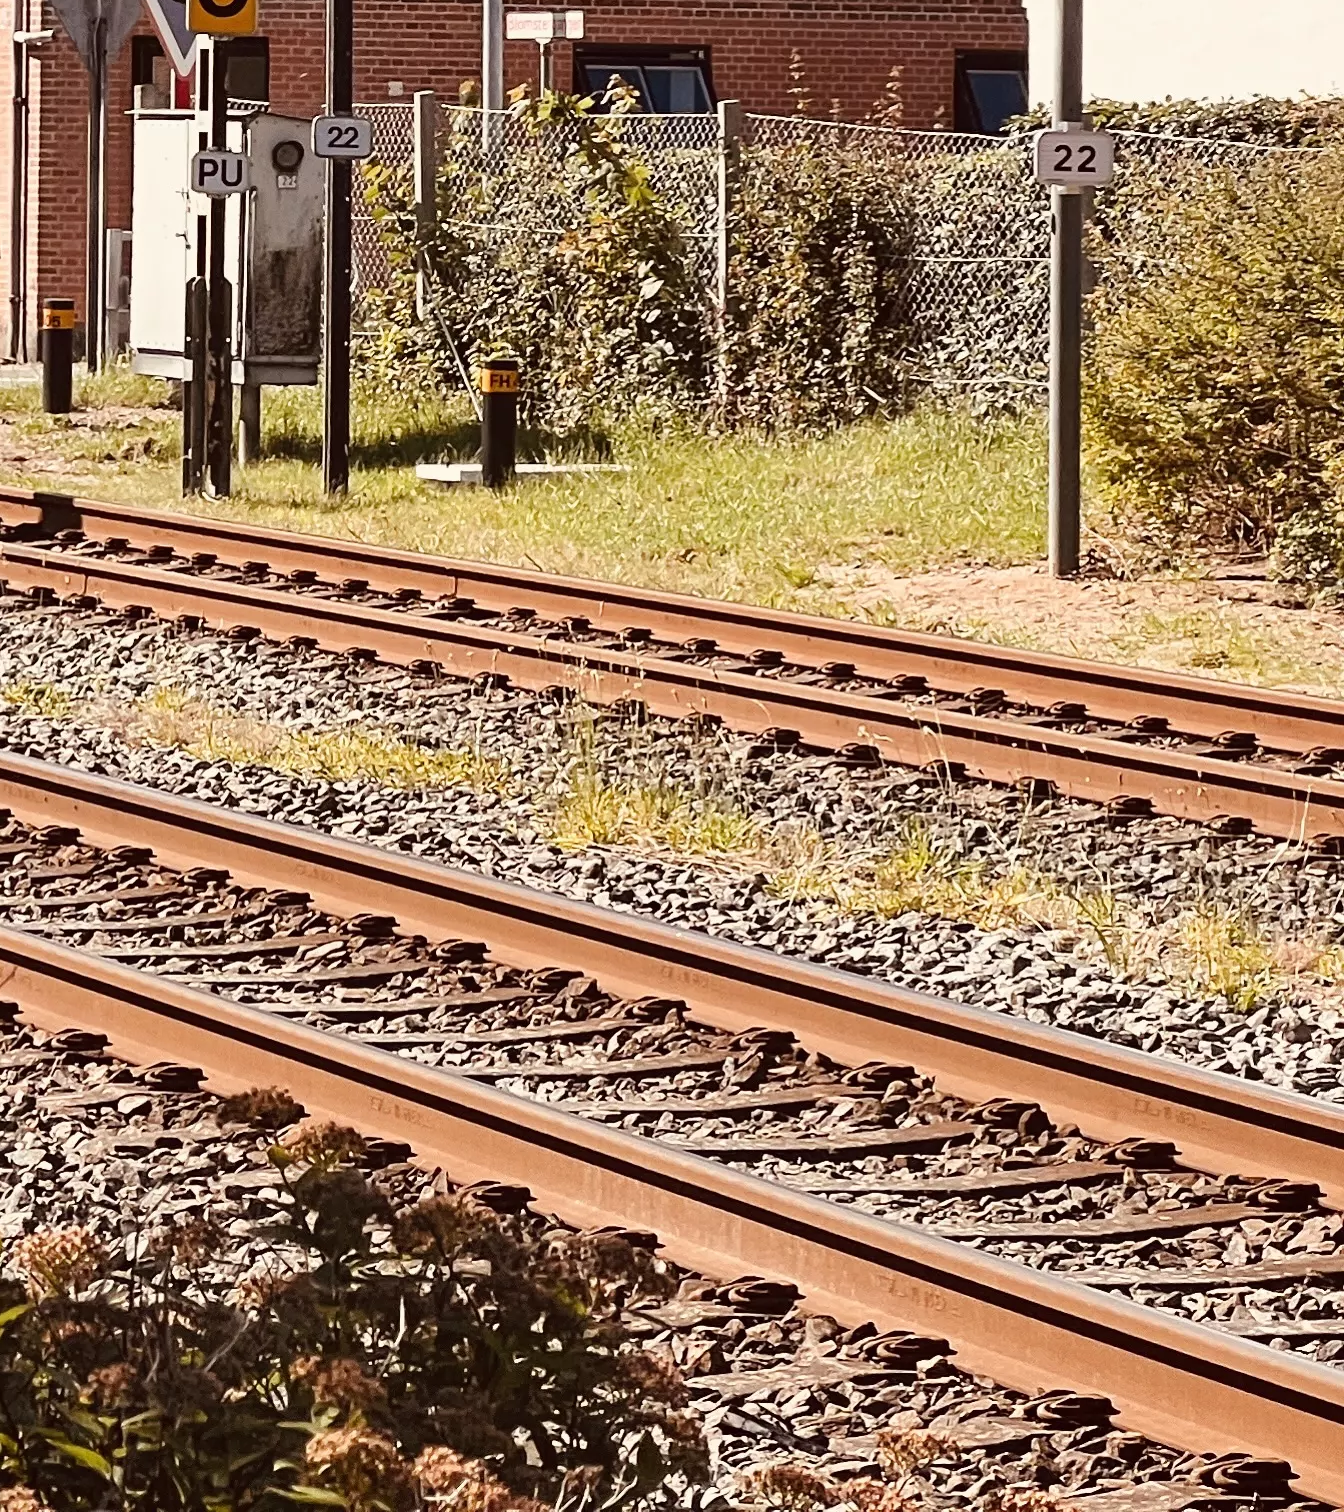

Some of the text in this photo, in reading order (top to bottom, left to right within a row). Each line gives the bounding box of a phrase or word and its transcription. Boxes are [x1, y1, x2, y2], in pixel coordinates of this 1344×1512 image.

[327, 126, 359, 149] 22
[198, 158, 243, 187] PU
[1053, 144, 1097, 173] 22
